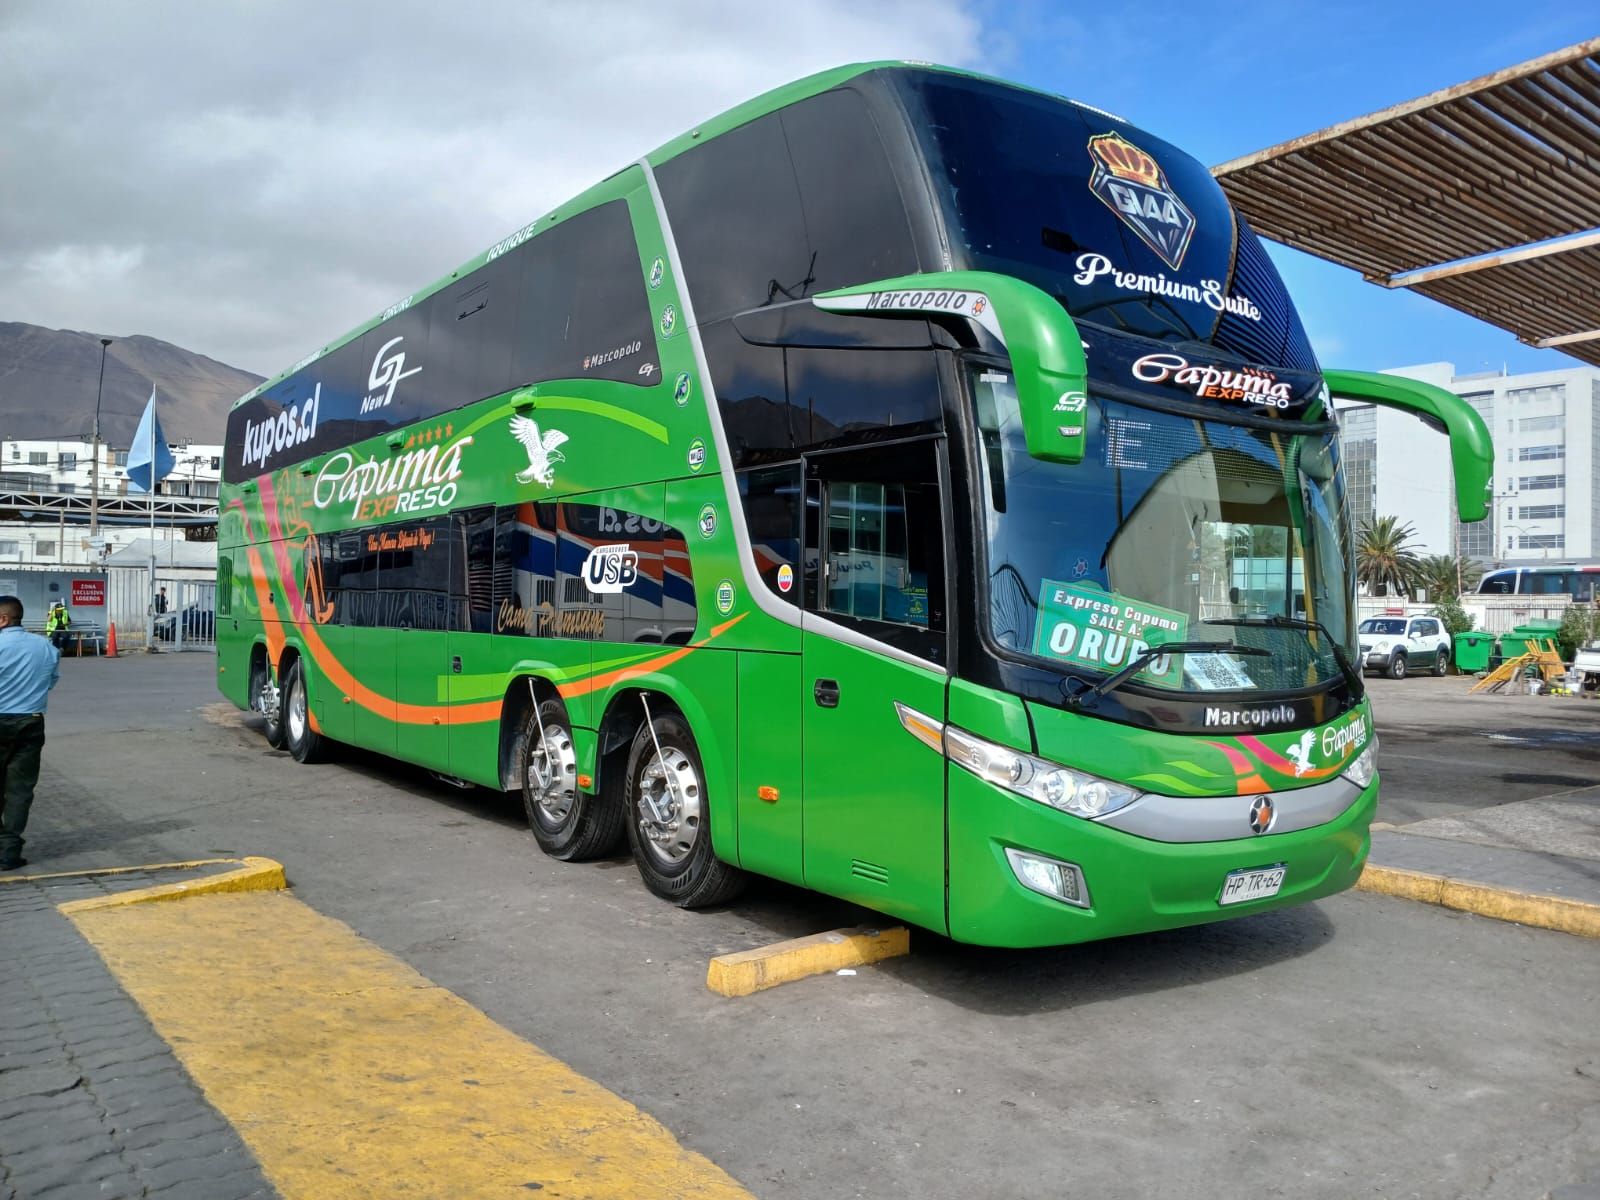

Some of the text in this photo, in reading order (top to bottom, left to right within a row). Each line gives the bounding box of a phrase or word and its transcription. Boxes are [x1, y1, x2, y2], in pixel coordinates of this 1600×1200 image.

[486, 222, 537, 263] IQUIQUE
[866, 290, 968, 311] Marcopolo
[1074, 253, 1262, 321] Premium Suite
[590, 340, 642, 369] Marcopolo
[1132, 354, 1293, 401] Capuma
[360, 394, 385, 416] New
[1053, 403, 1077, 412] New
[1203, 387, 1289, 409] EXPRESO
[242, 382, 322, 470] kupos.cl
[313, 436, 474, 521] Capuma
[358, 482, 458, 521] EXPRESO
[589, 553, 638, 586] USB
[1053, 589, 1179, 631] Expreso Capuma
[1089, 613, 1142, 637] SALE A:
[1205, 704, 1296, 727] Marcopolo
[1322, 713, 1366, 759] Capuma
